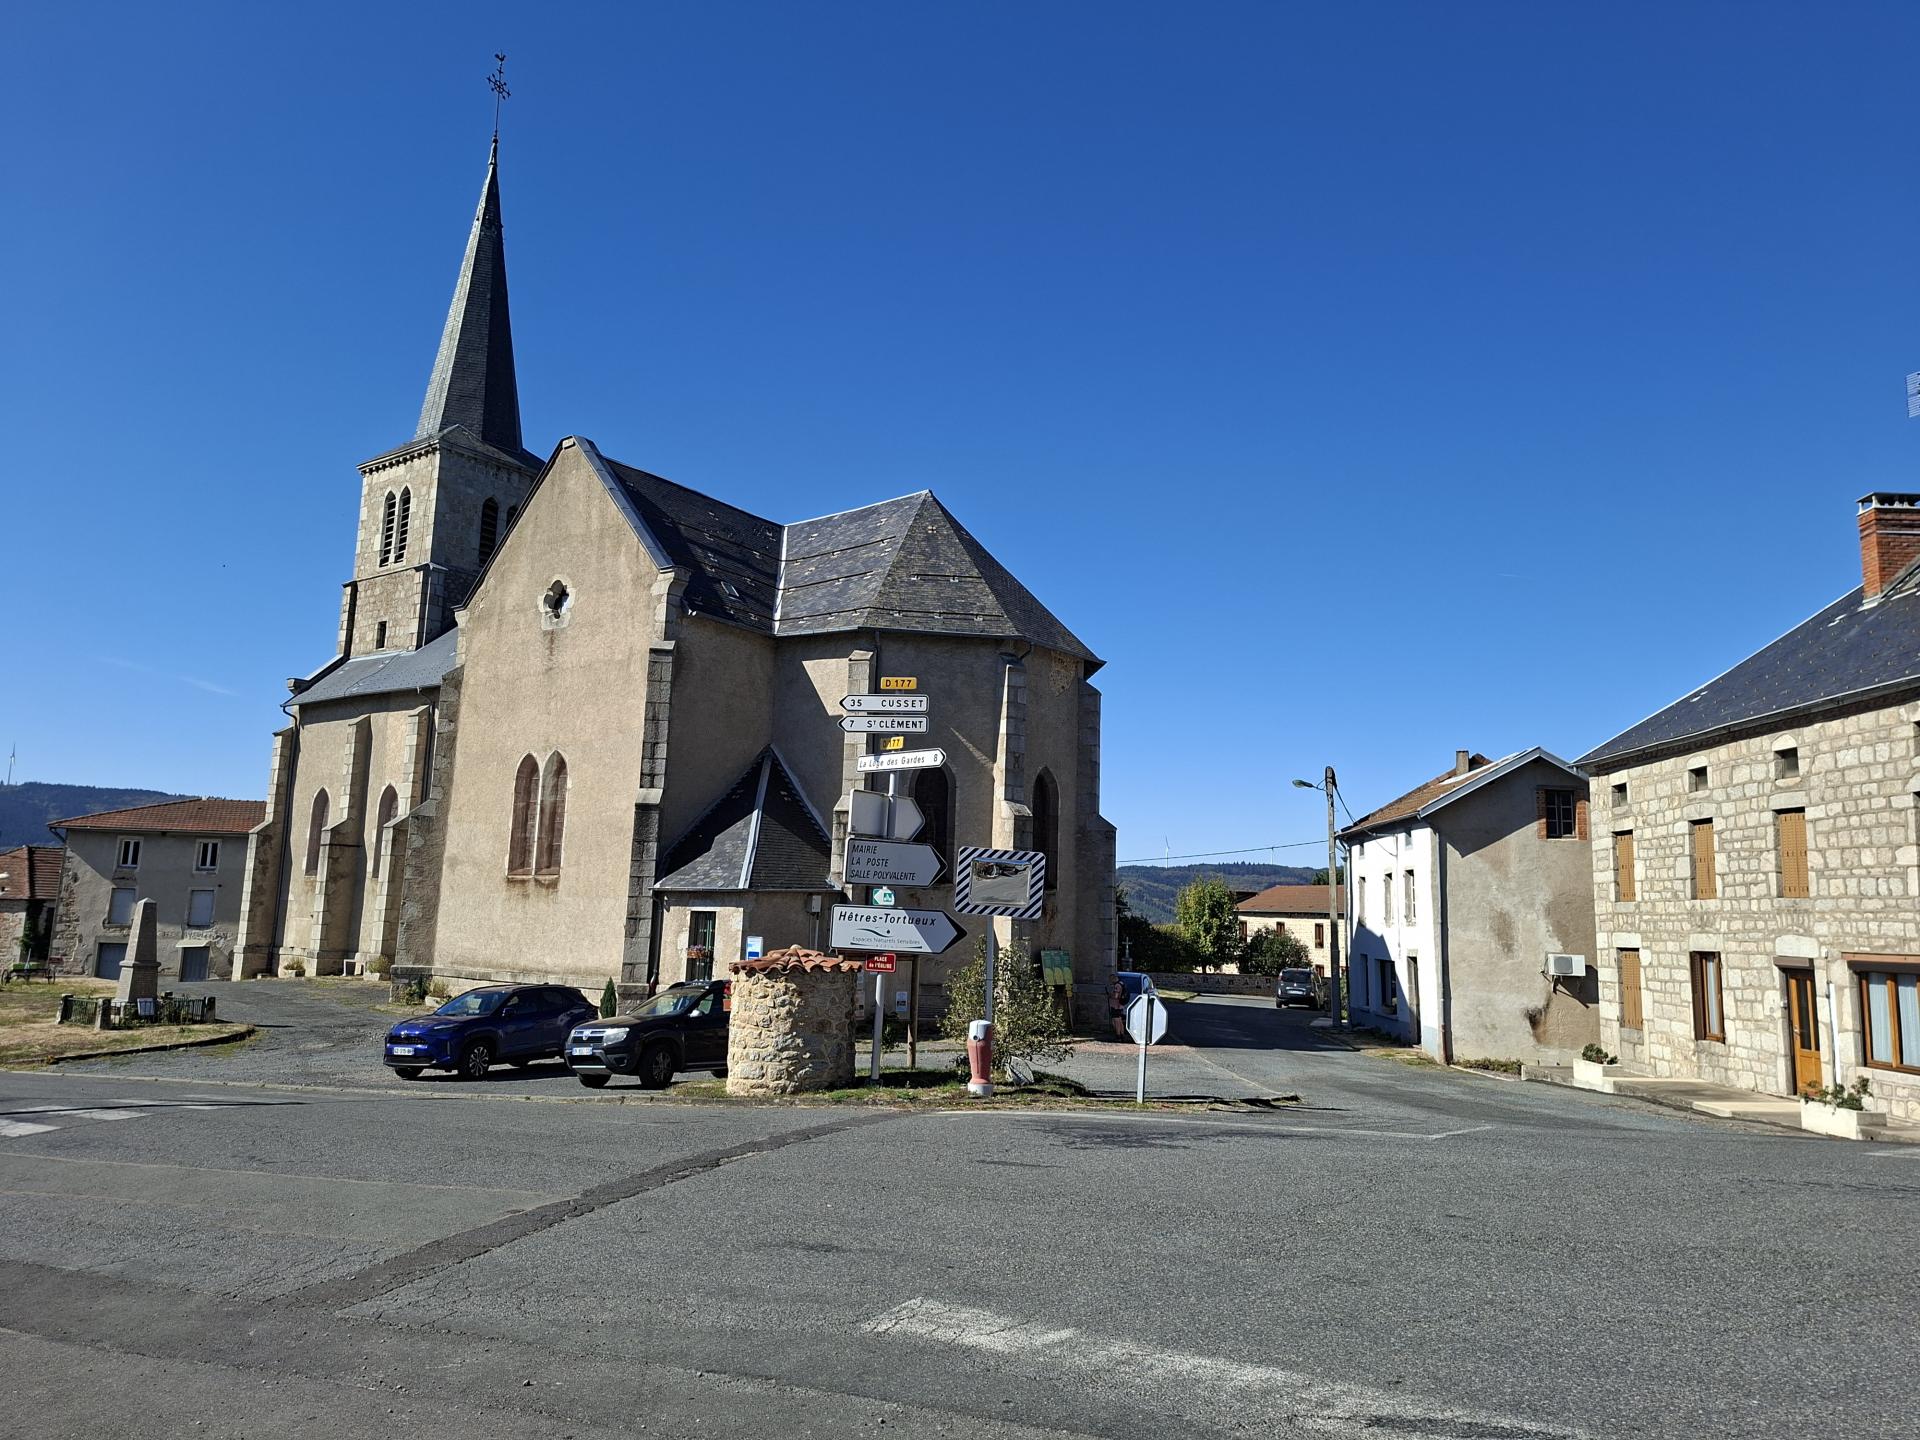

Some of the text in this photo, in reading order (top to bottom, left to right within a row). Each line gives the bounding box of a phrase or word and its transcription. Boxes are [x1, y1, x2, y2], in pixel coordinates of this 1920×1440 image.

[885, 679, 912, 688] D 177
[850, 699, 924, 708] 35 CUSSET
[849, 720, 855, 728] 7
[879, 718, 924, 729] CLÉMENT
[859, 760, 867, 768] La
[887, 758, 898, 766] des
[901, 756, 925, 765] Gardes
[933, 753, 938, 762] 8
[851, 844, 878, 854] MAIRIE
[851, 857, 889, 867] LA POSTE
[850, 869, 916, 881] SALLE POLYVALENTE
[838, 911, 937, 926] Hêtres-Tortueux
